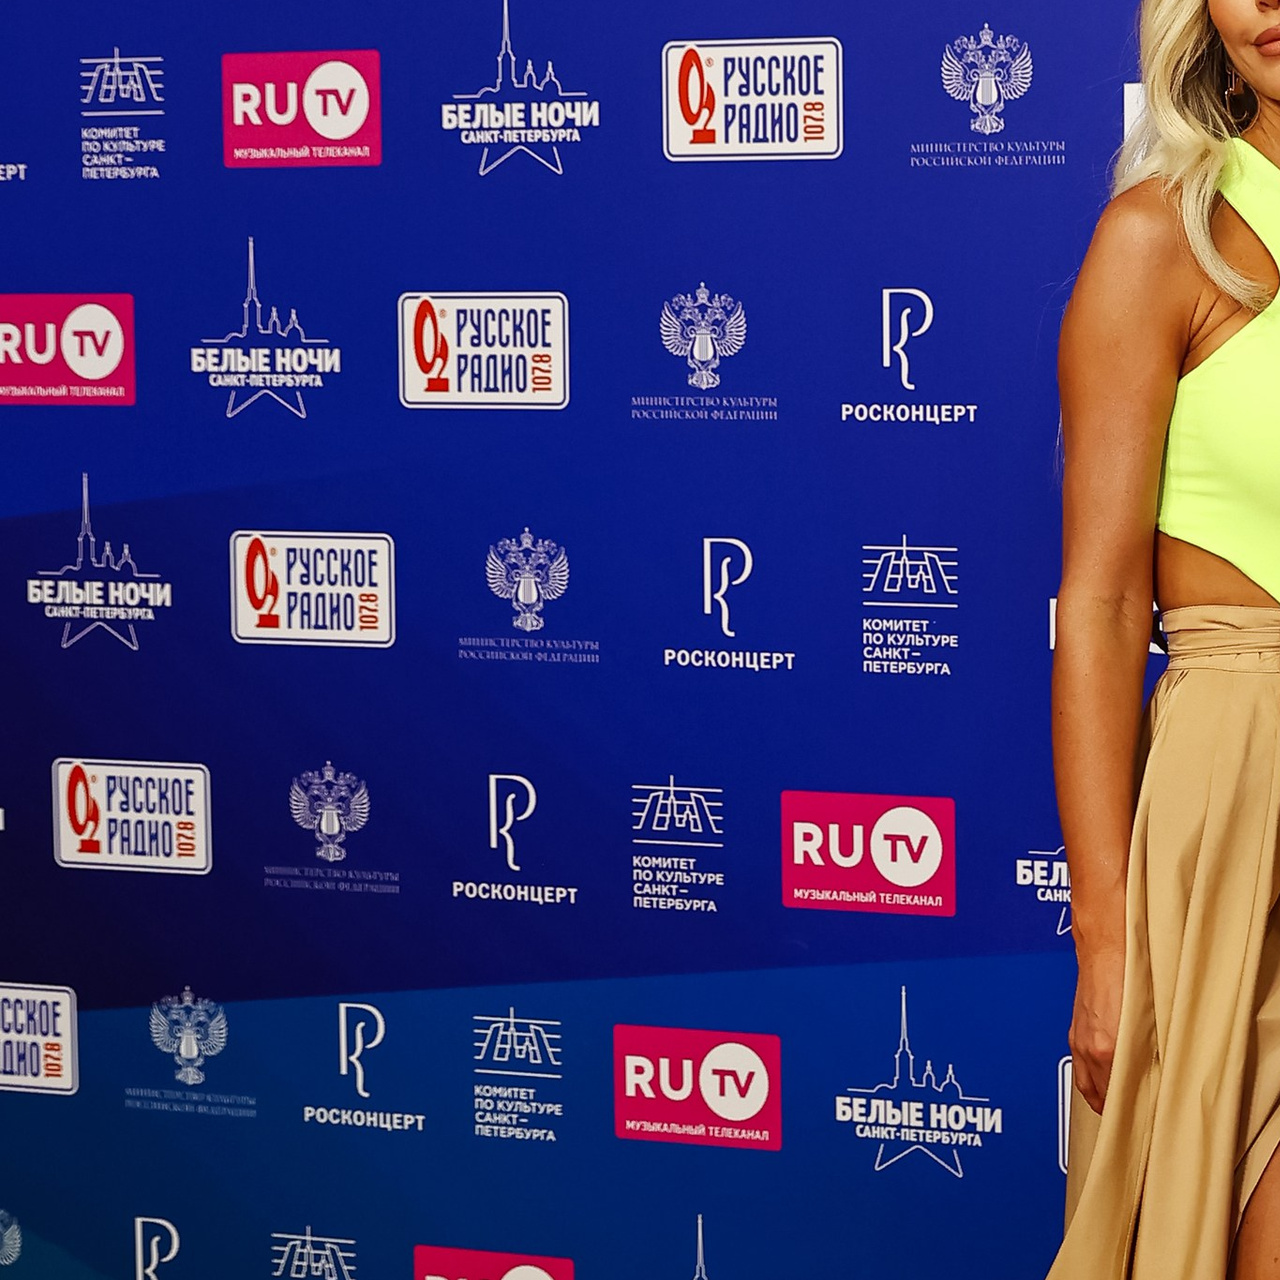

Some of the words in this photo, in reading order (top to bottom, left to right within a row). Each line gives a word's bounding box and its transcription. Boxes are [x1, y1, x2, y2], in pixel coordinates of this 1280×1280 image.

[723, 54, 824, 97] РУССКОЕ
[441, 101, 525, 130] БЕЛЫЕ
[530, 100, 599, 129] НОЧИ
[723, 102, 799, 144] РАДИО
[460, 128, 581, 145] САНКТ-ПЕТЕРБУРГА
[455, 309, 552, 348] РУССКОЕ
[190, 346, 271, 373] БЕЛЫЕ
[275, 347, 340, 373] НОЧИ
[209, 373, 323, 388] САНКТ-ПЕТЕРБУРГА
[456, 354, 528, 394] РАДИО
[841, 404, 978, 426] РОСКОНЦЕРТ
[285, 547, 378, 587] РУССКОЕ
[286, 591, 355, 632] РАДИО
[862, 618, 930, 633] КОМИТЕТ
[862, 632, 884, 646] ПО
[886, 632, 959, 648] КУЛЬТУРЕ
[663, 648, 796, 672] РОСКОНЦЕРТ
[862, 660, 952, 676] ПЕТЕРБУРГА
[105, 775, 195, 815] РУССКОЕ
[106, 817, 173, 858] РАДИО
[452, 880, 578, 906] РОСКОНЦЕРТ
[793, 887, 877, 904] МУЗЫКАЛЬНЫЙ
[879, 891, 943, 907] ТЕЛЕКАНАЛ
[303, 1105, 426, 1132] РОСКОНЦЕРТ
[835, 1095, 924, 1129] БЕЛЫЕ
[929, 1102, 1002, 1135] НОЧИ
[625, 1119, 706, 1137] МУЗЫКАЛЬНЫЙ
[708, 1125, 770, 1142] ТЕЛЕКАНАЛ
[855, 1123, 982, 1148] САНКТ-ПЕТЕРБУРГА
